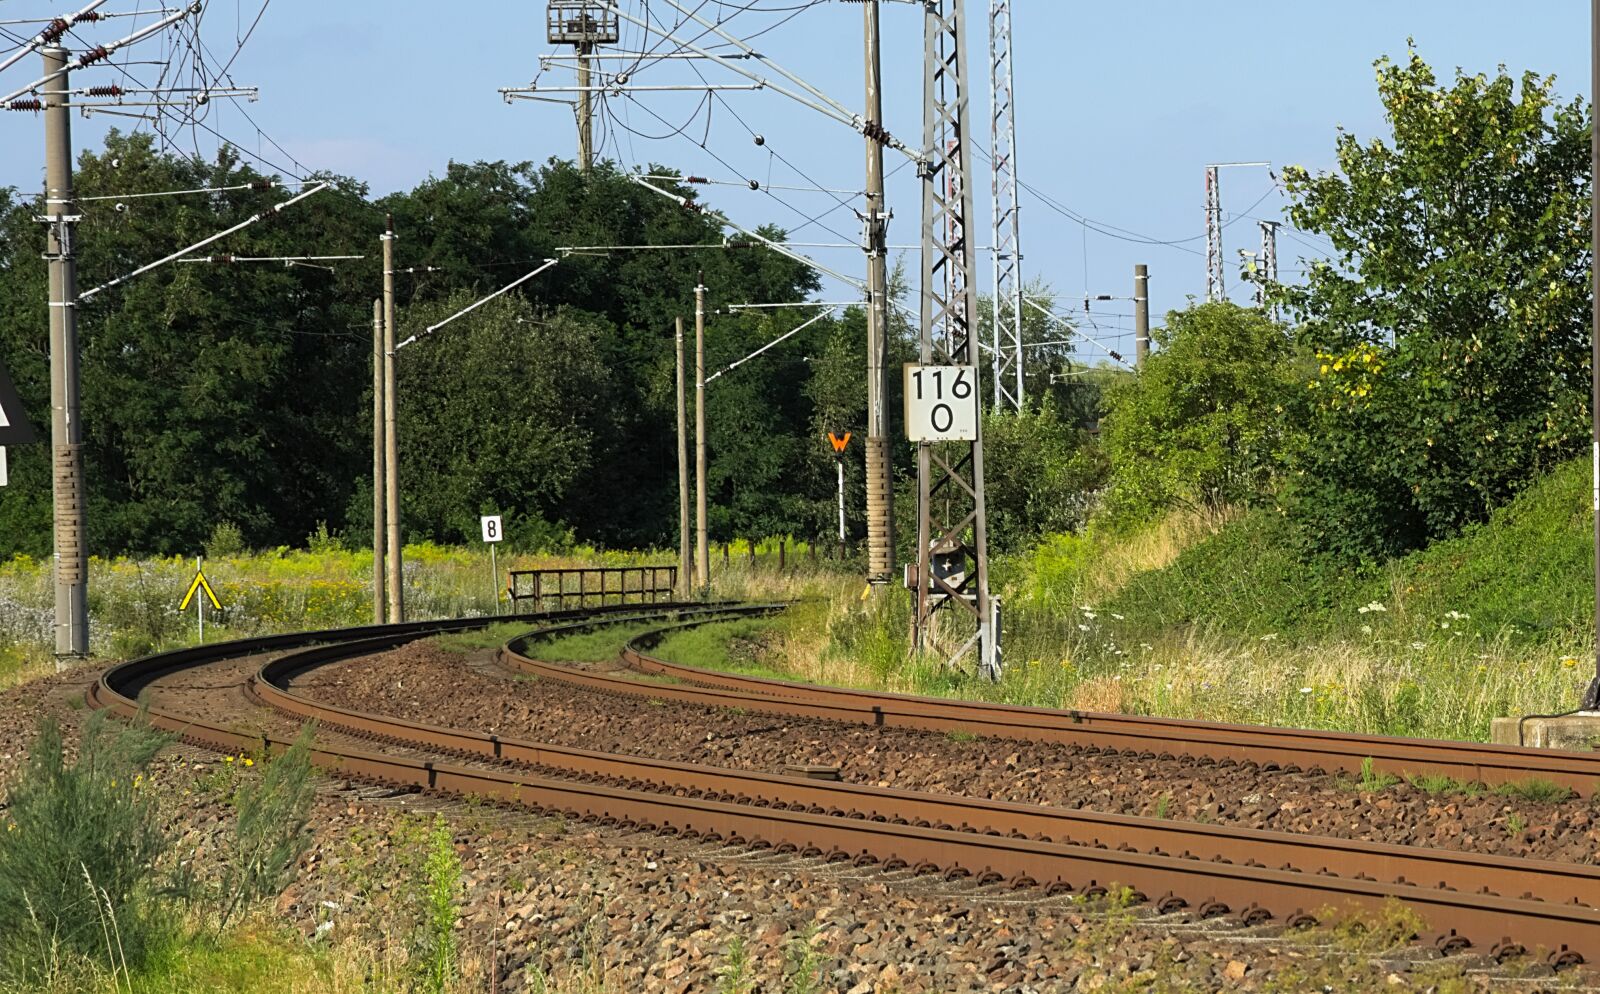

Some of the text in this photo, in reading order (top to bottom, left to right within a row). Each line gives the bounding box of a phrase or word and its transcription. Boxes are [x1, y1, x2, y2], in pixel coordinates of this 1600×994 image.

[913, 370, 971, 399] 116
[931, 403, 953, 432] 0
[828, 431, 851, 452] W
[487, 520, 497, 538] 8
